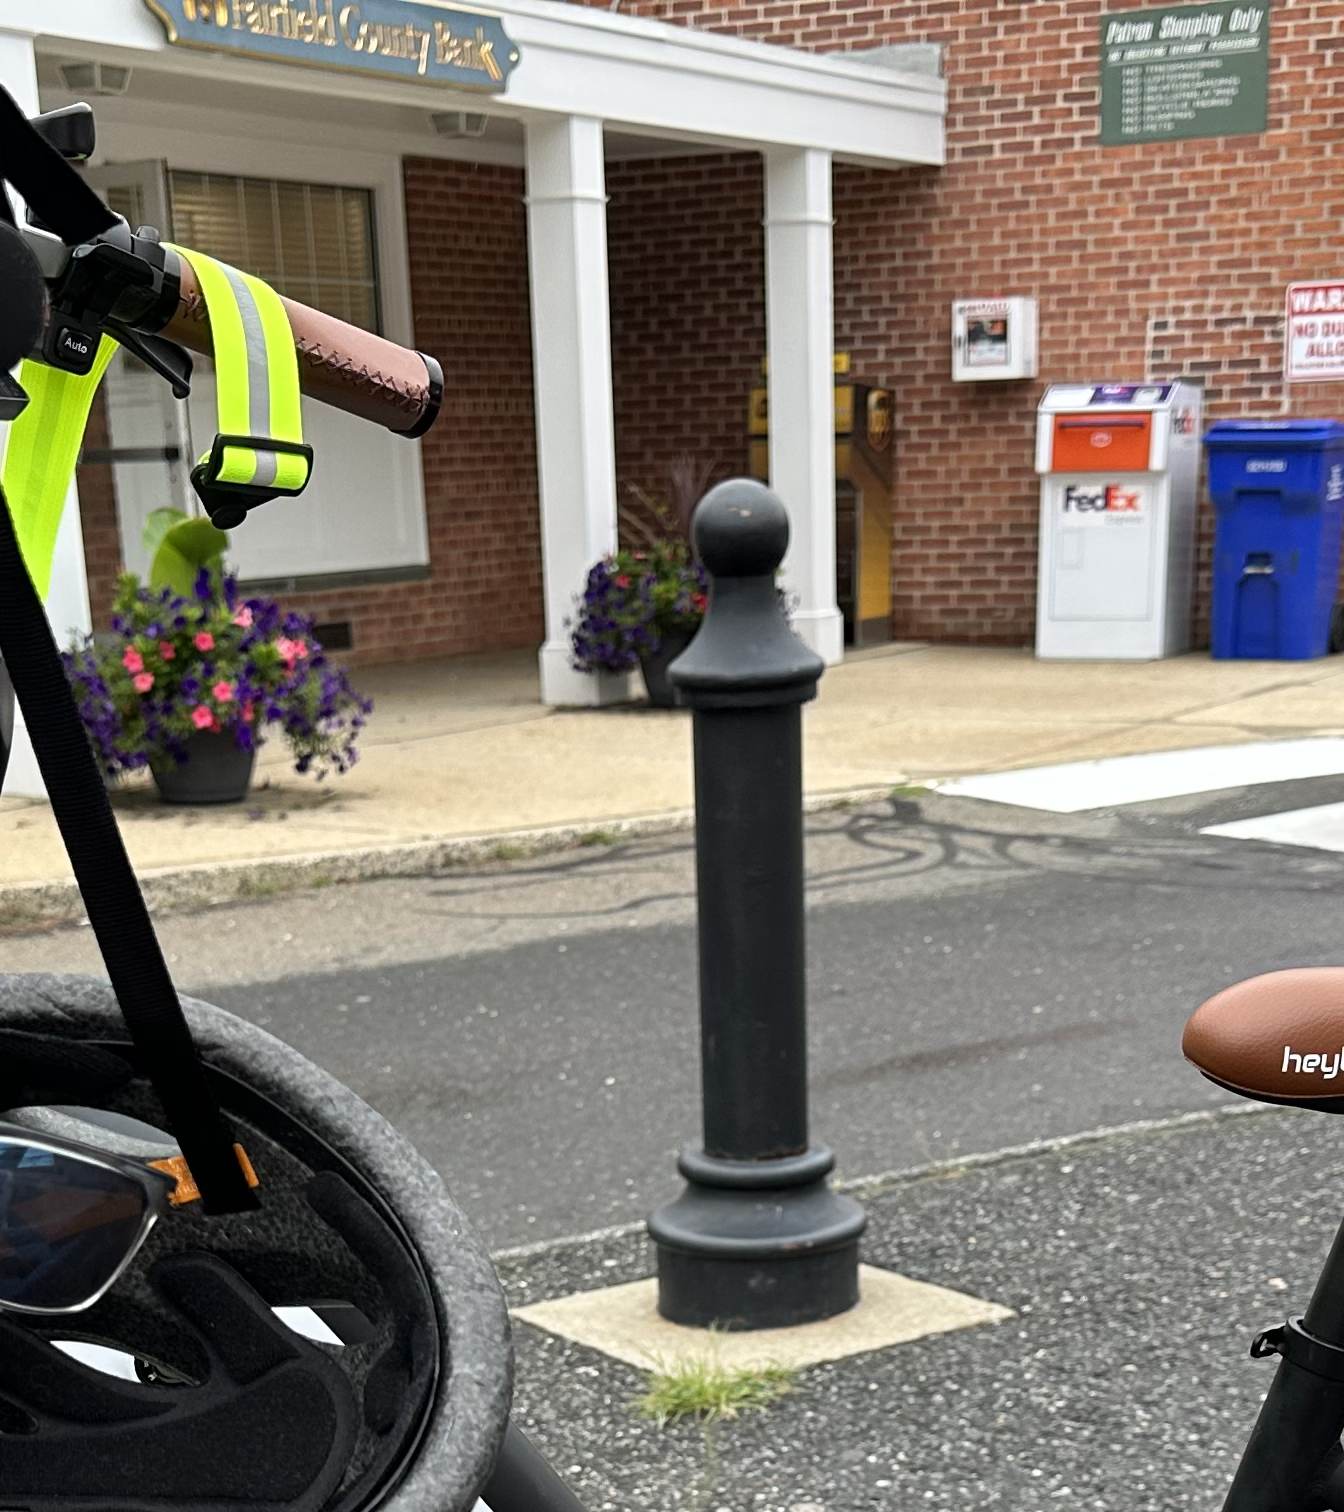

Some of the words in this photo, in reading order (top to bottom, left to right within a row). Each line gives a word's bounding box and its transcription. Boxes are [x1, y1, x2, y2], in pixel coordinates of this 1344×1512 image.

[231, 0, 338, 47] Fairfield
[339, 5, 431, 75] County
[434, 20, 504, 81] Bank
[1296, 321, 1318, 338] NO
[64, 337, 88, 354] Auto
[1064, 484, 1141, 512] FedEx
